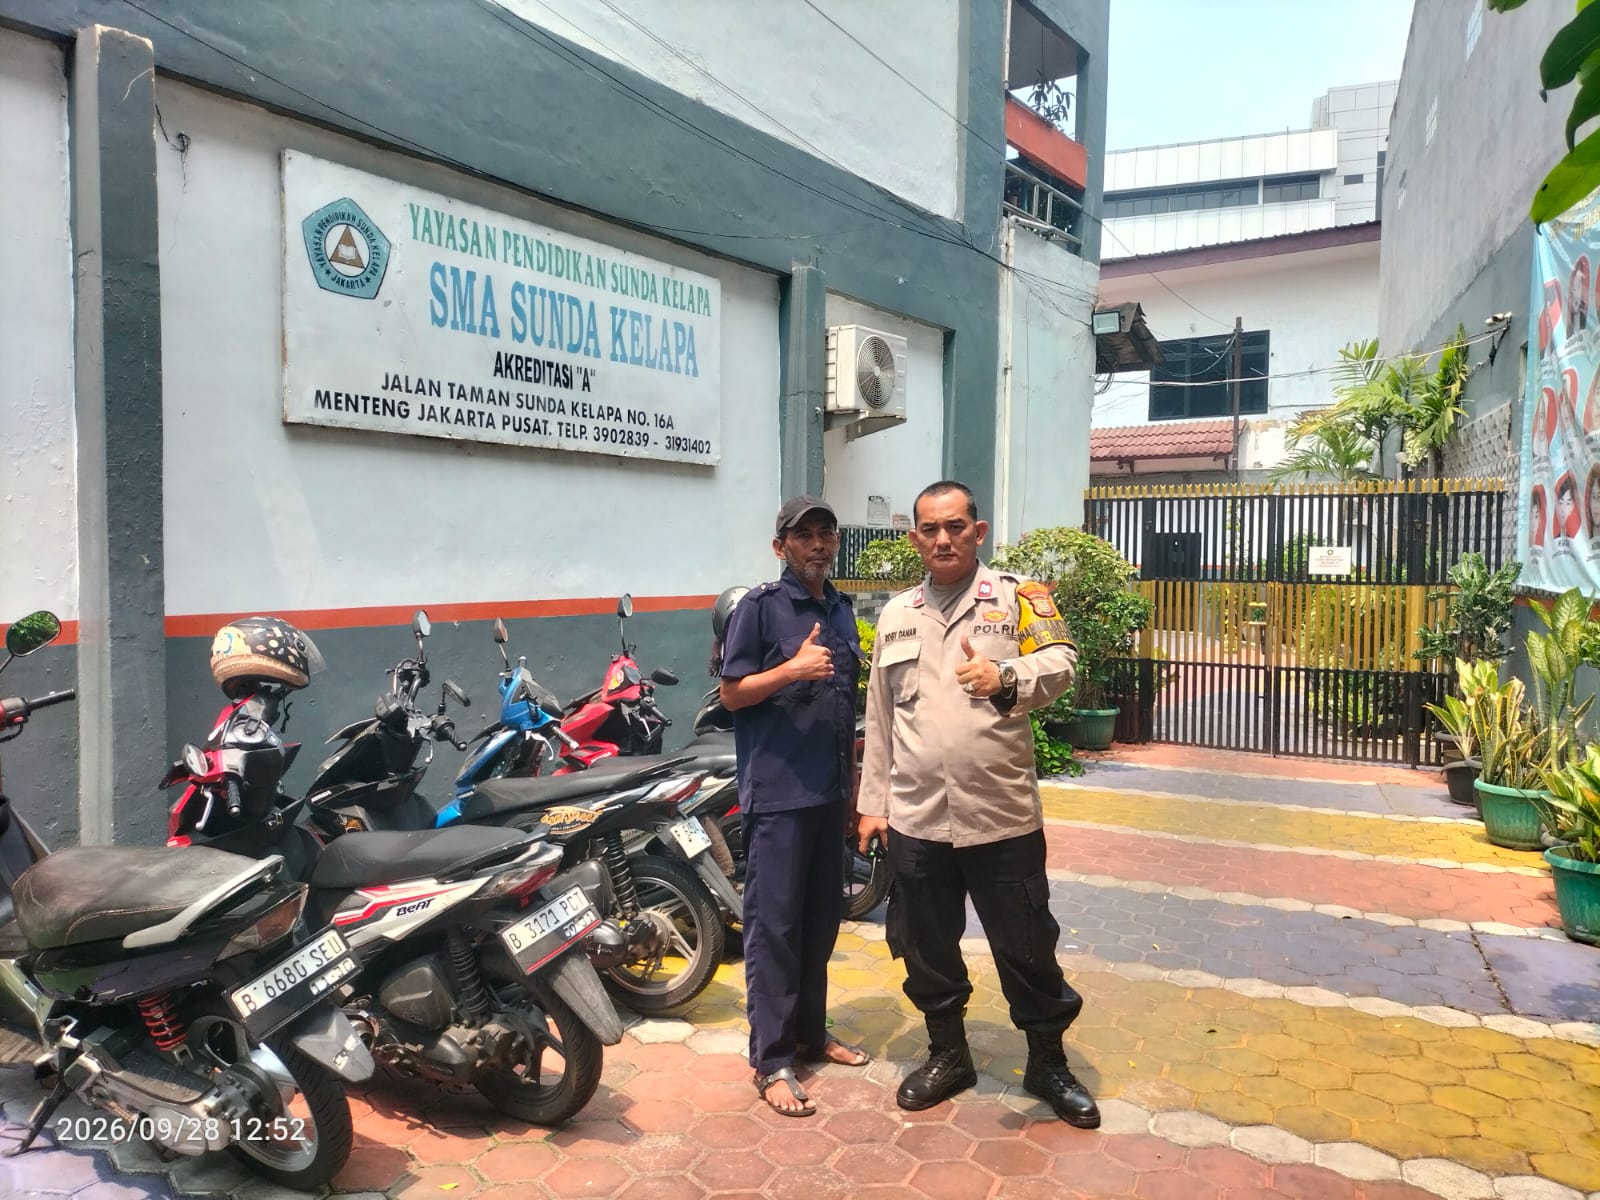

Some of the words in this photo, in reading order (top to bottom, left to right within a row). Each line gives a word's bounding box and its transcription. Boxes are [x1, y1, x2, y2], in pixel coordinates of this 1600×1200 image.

[357, 219, 377, 244] SUNDA
[369, 244, 381, 277] KELAPA
[409, 202, 497, 262] YAYASAN
[502, 229, 606, 291] PENDIDIKAN
[611, 262, 658, 304] SUNDA
[662, 276, 711, 317] KELAPA
[331, 274, 366, 290] JAKARTA
[430, 261, 500, 338] SMA
[511, 281, 601, 358] SUNDA
[609, 305, 699, 378] KELAPA
[493, 350, 574, 390] AKREDITASI
[314, 389, 410, 419] MENTENG
[418, 403, 496, 429] JAKARTA
[502, 414, 552, 436] PUSAT.
[557, 421, 588, 441] TELP.
[593, 426, 649, 447] 3902839
[665, 435, 711, 455] 31931402
[381, 372, 441, 398] JALAN
[447, 382, 510, 407] TAMAN
[516, 392, 566, 415] SUNDA
[571, 401, 622, 423] KELAPA
[627, 409, 650, 427] NO.
[654, 413, 674, 430] 16A
[973, 624, 1016, 636] POLRI
[509, 933, 522, 949] B
[524, 908, 560, 938] 3171
[559, 891, 585, 917] PCT
[241, 993, 257, 1012] B
[310, 936, 343, 967] SEU
